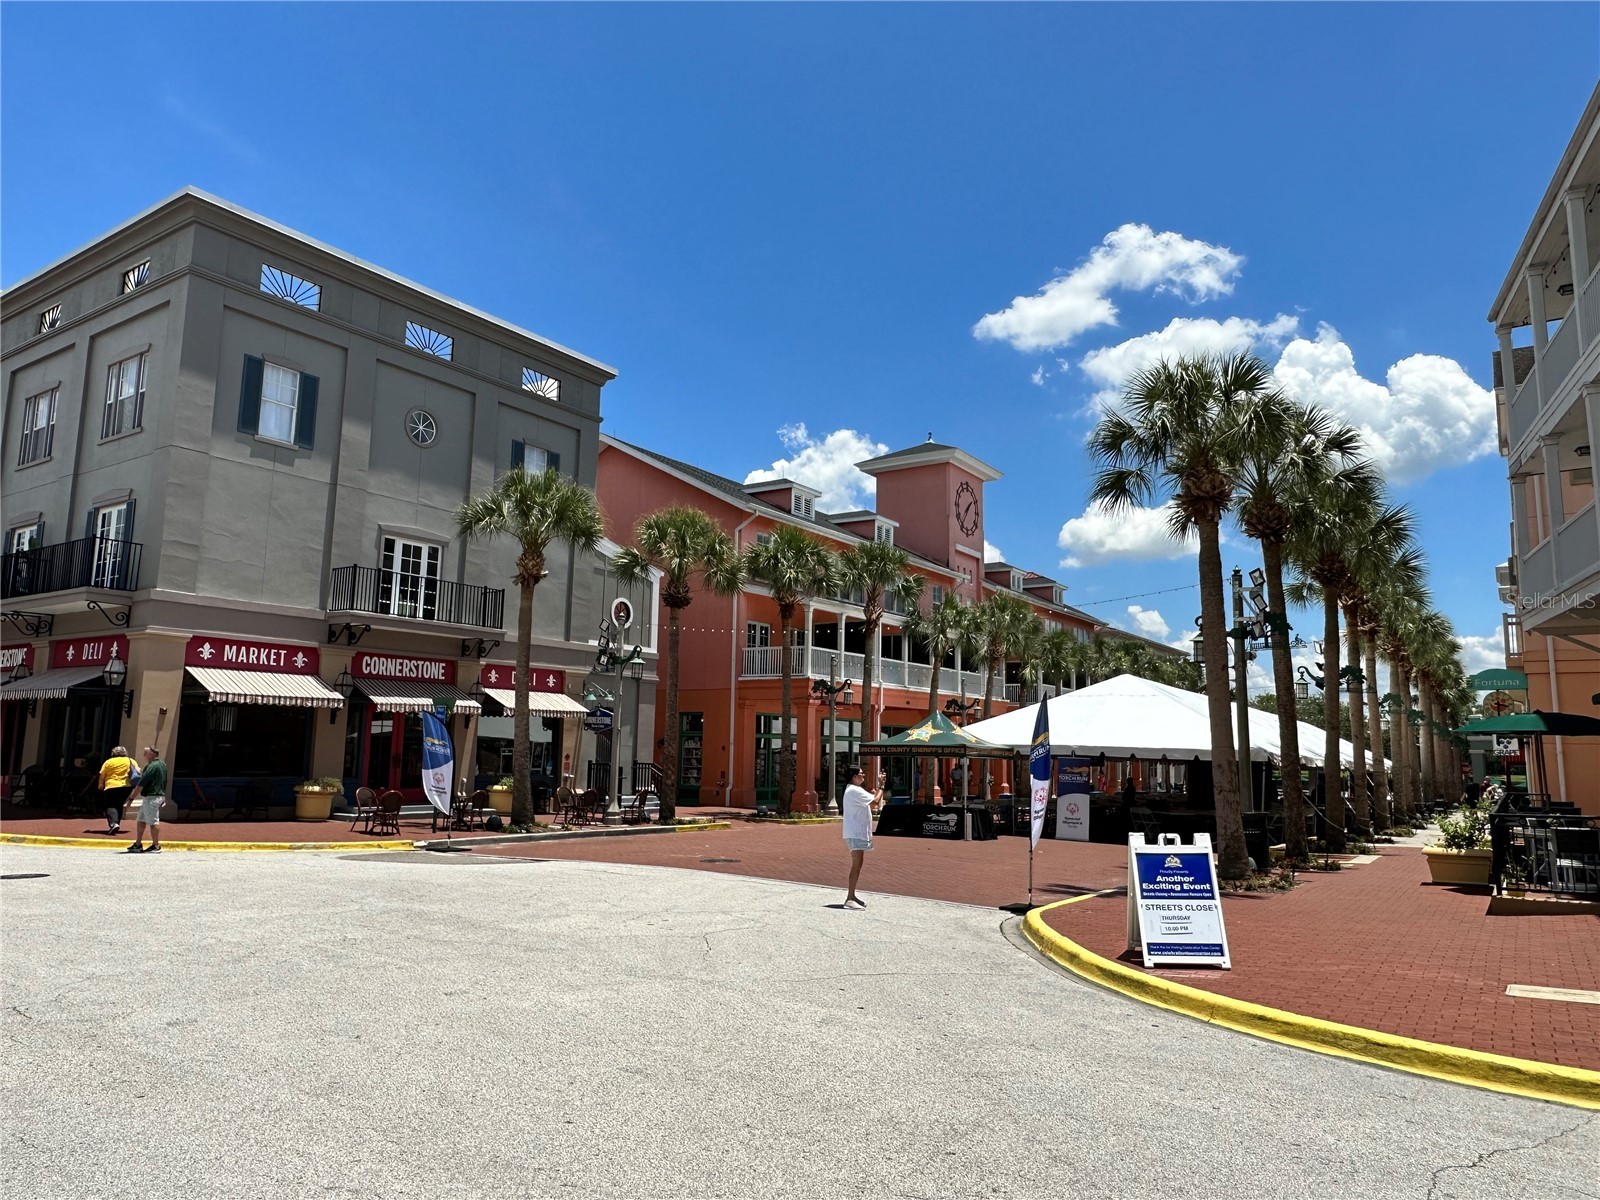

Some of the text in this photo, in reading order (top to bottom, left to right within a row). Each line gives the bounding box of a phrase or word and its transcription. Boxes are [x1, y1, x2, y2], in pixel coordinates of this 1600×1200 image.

[82, 642, 104, 660] DELI
[223, 644, 288, 667] MARKET
[362, 655, 446, 680] CORNERSTONE
[1474, 678, 1519, 687] Fortuna
[922, 823, 943, 831] TORCH
[1143, 883, 1180, 891] Exciting
